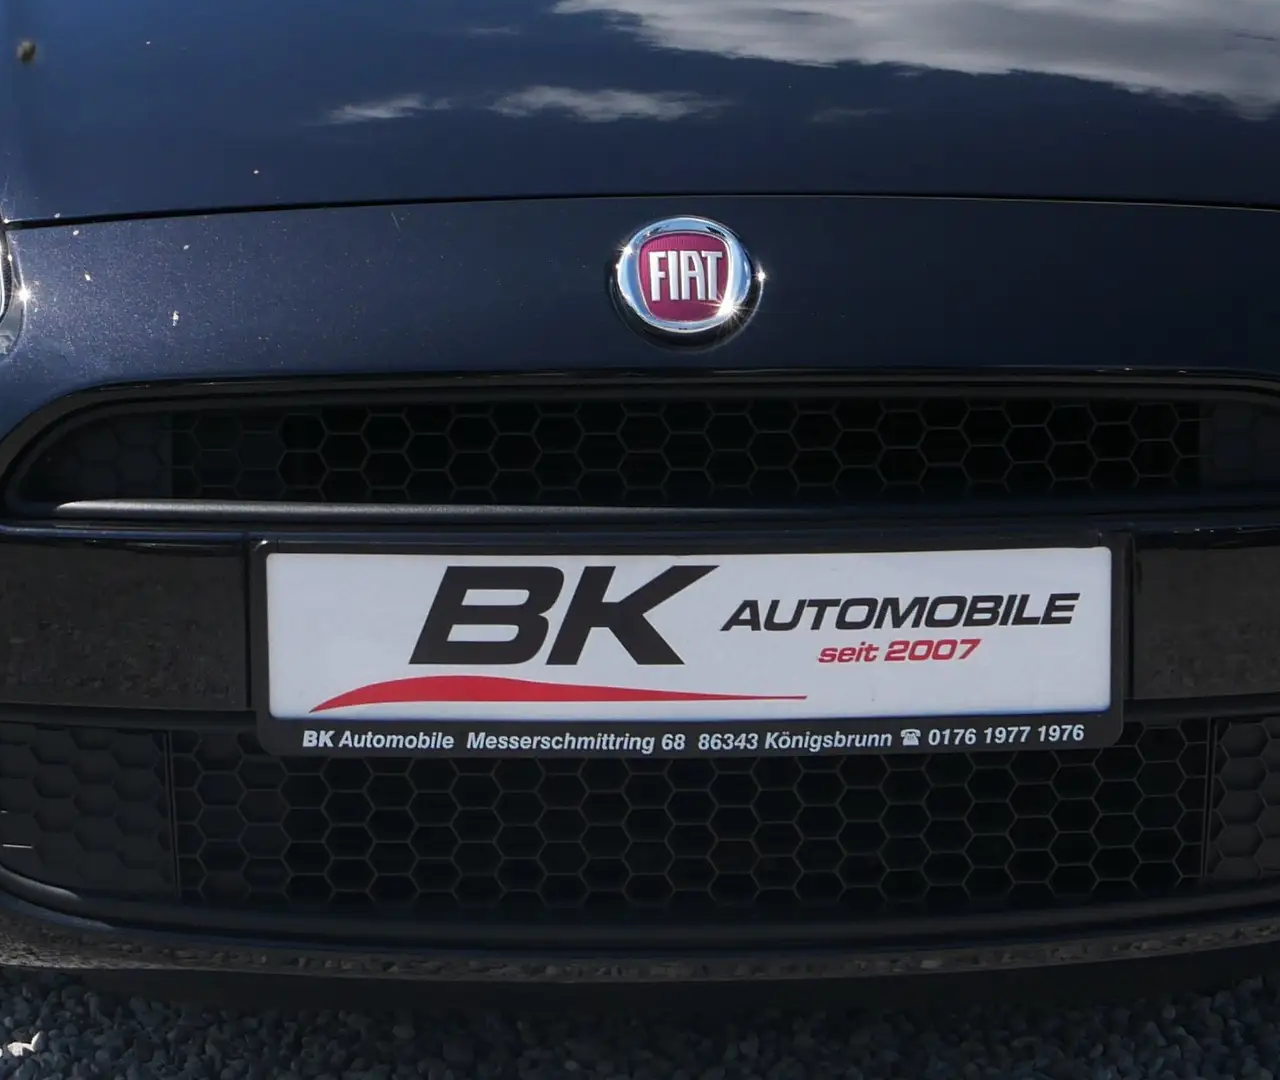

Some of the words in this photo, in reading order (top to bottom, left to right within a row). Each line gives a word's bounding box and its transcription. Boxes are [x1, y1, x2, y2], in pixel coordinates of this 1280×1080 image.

[648, 250, 723, 302] FIAT
[409, 565, 720, 666] BK
[720, 592, 1081, 632] AUTOMOBILE
[818, 643, 878, 664] seit
[885, 638, 982, 662] 2007
[302, 729, 335, 748] BK
[338, 730, 455, 750] Automobile
[466, 731, 655, 755] Messerschmittring
[661, 733, 686, 751] 68
[697, 732, 759, 751] 86343
[764, 730, 893, 753] Königsbrunn
[927, 727, 977, 746] 0176
[983, 725, 1032, 744] 1977
[1037, 723, 1085, 743] 1976
